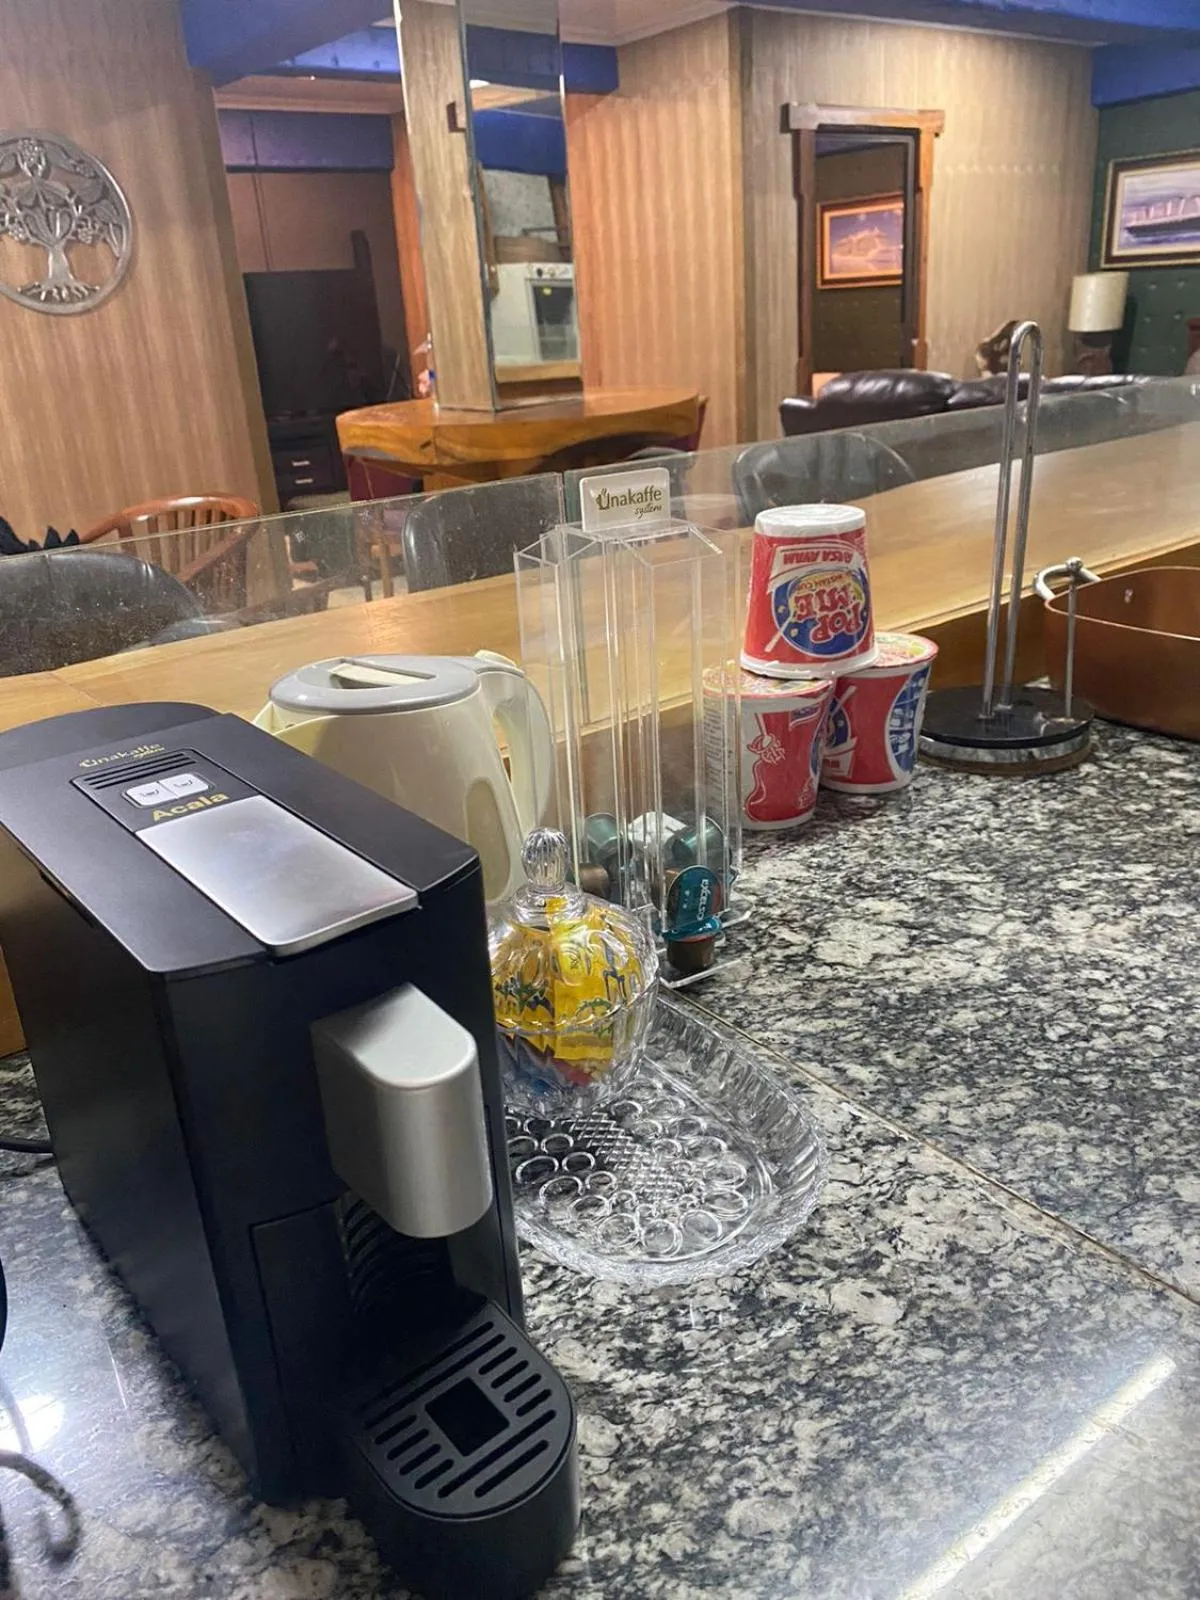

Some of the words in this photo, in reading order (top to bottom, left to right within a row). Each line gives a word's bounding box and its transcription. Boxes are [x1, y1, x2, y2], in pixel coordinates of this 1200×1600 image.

[595, 485, 662, 510] Unakaffe
[634, 504, 662, 519] system
[794, 586, 852, 621] MIE
[809, 602, 863, 643] POP
[151, 791, 230, 822] Acala
